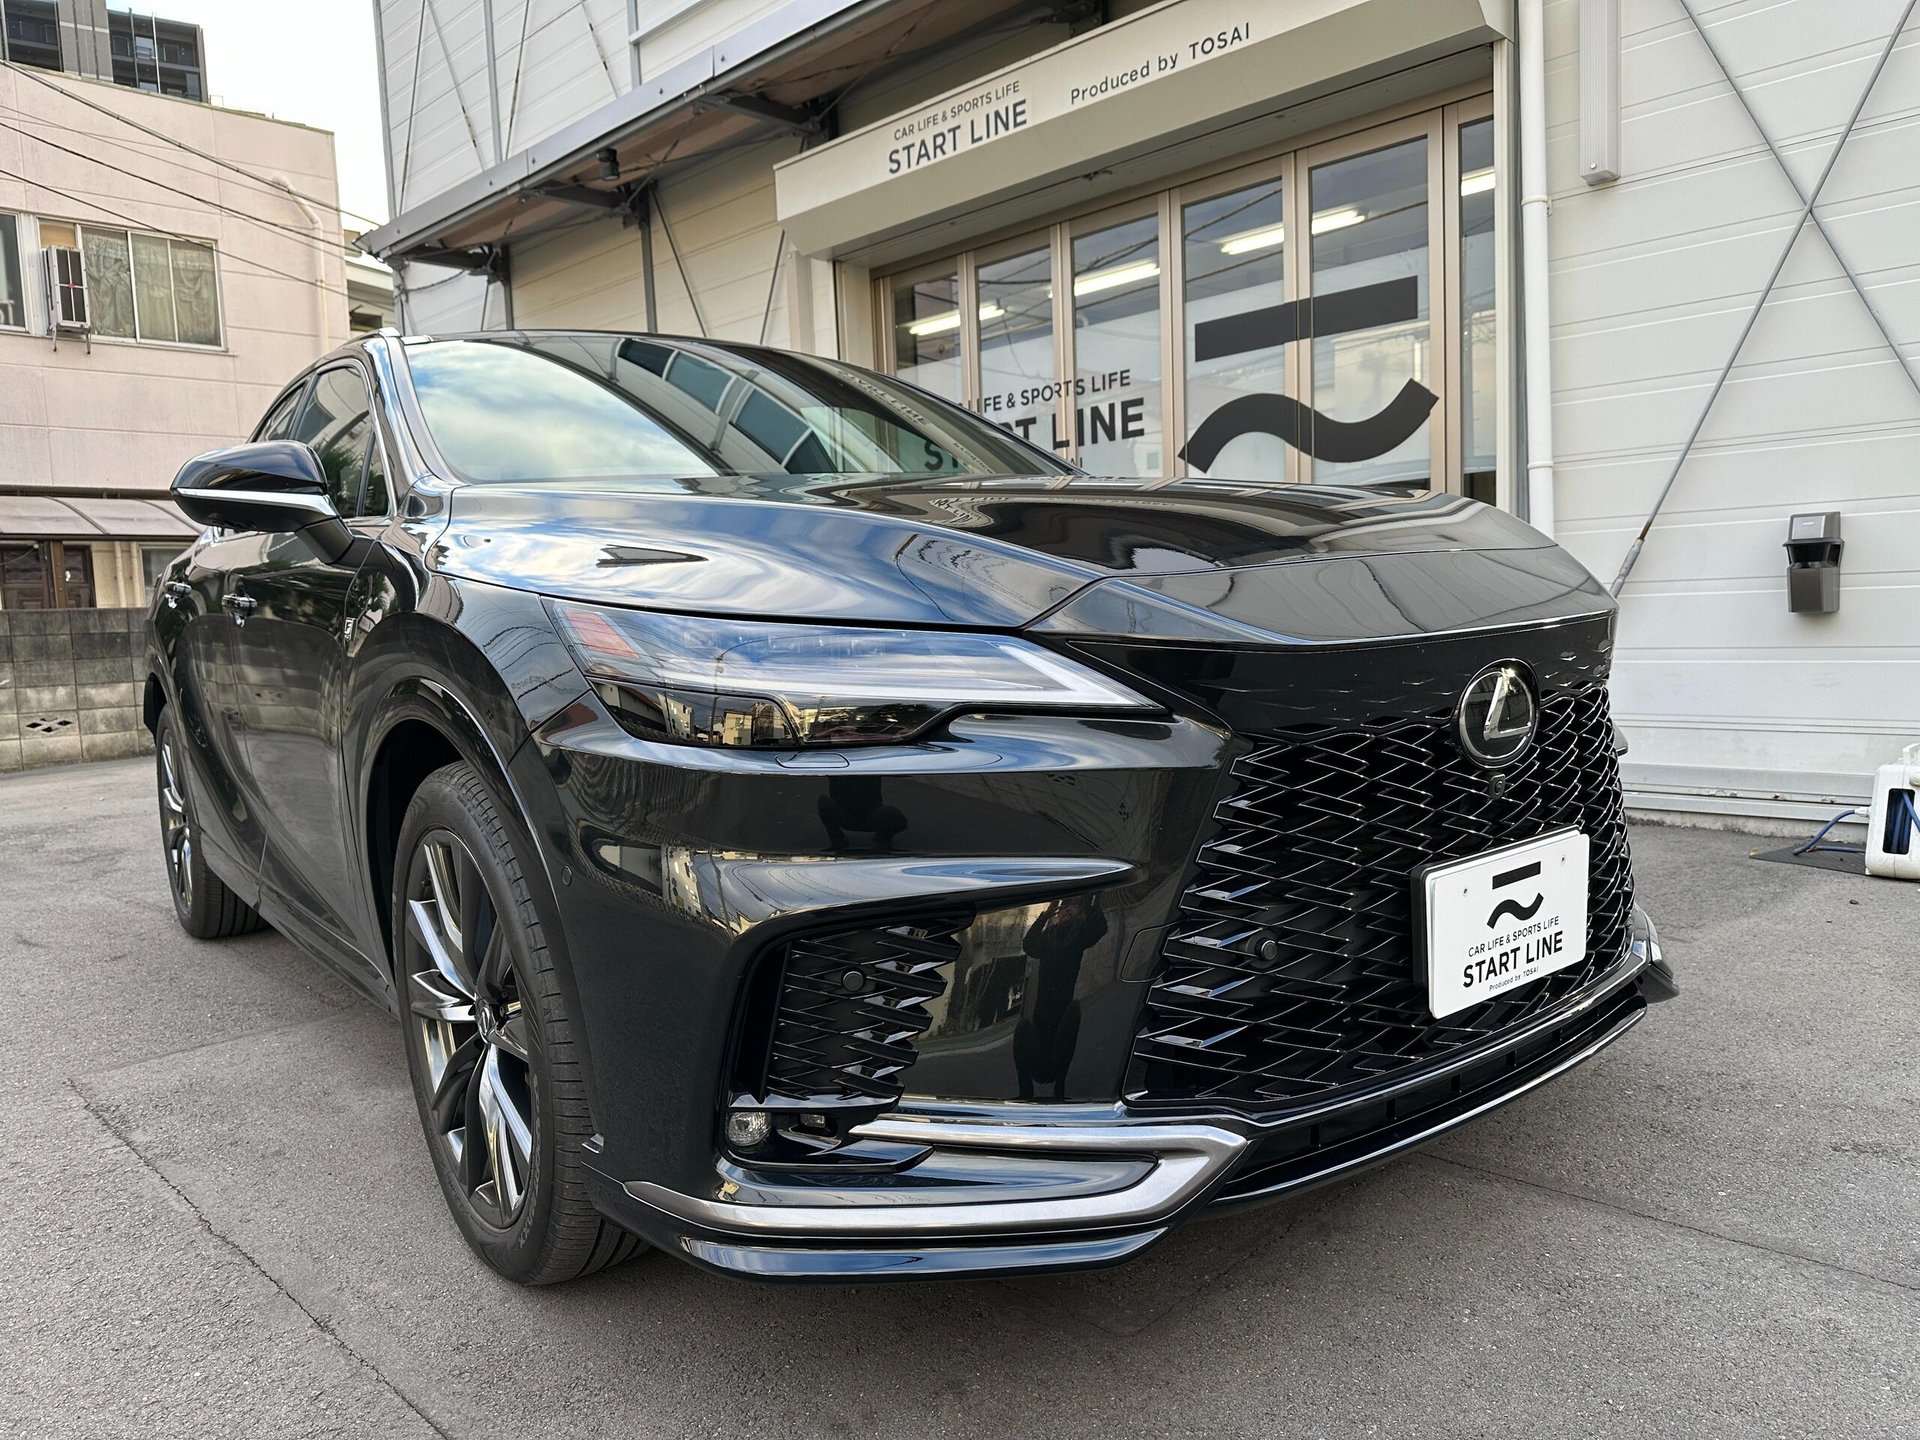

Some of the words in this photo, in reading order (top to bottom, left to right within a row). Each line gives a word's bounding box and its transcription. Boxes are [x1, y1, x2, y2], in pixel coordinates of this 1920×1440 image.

[1071, 60, 1150, 104] Produced
[1158, 53, 1178, 72] by
[1189, 22, 1250, 59] TOSAI
[889, 124, 961, 174] START
[970, 99, 1027, 144] LINE
[894, 123, 915, 141] CAR
[917, 113, 939, 131] LIFE
[941, 110, 948, 122] &
[950, 92, 992, 118] SPORTS
[995, 80, 1020, 100] LIFE
[1006, 392, 1016, 408] &
[1020, 379, 1085, 406] SPORTS
[1092, 369, 1131, 392] LIFE
[1052, 397, 1145, 450] LINE
[1463, 946, 1520, 988] START
[1526, 930, 1563, 964] LINE
[1468, 943, 1486, 957] CAR
[1487, 936, 1504, 951] LIFE
[1505, 934, 1511, 944] &
[1512, 922, 1541, 941] SPORTS
[1543, 915, 1559, 930] LIFE
[1489, 977, 1513, 991] Produced
[1514, 974, 1521, 982] by
[1523, 966, 1539, 977] TOSAI
